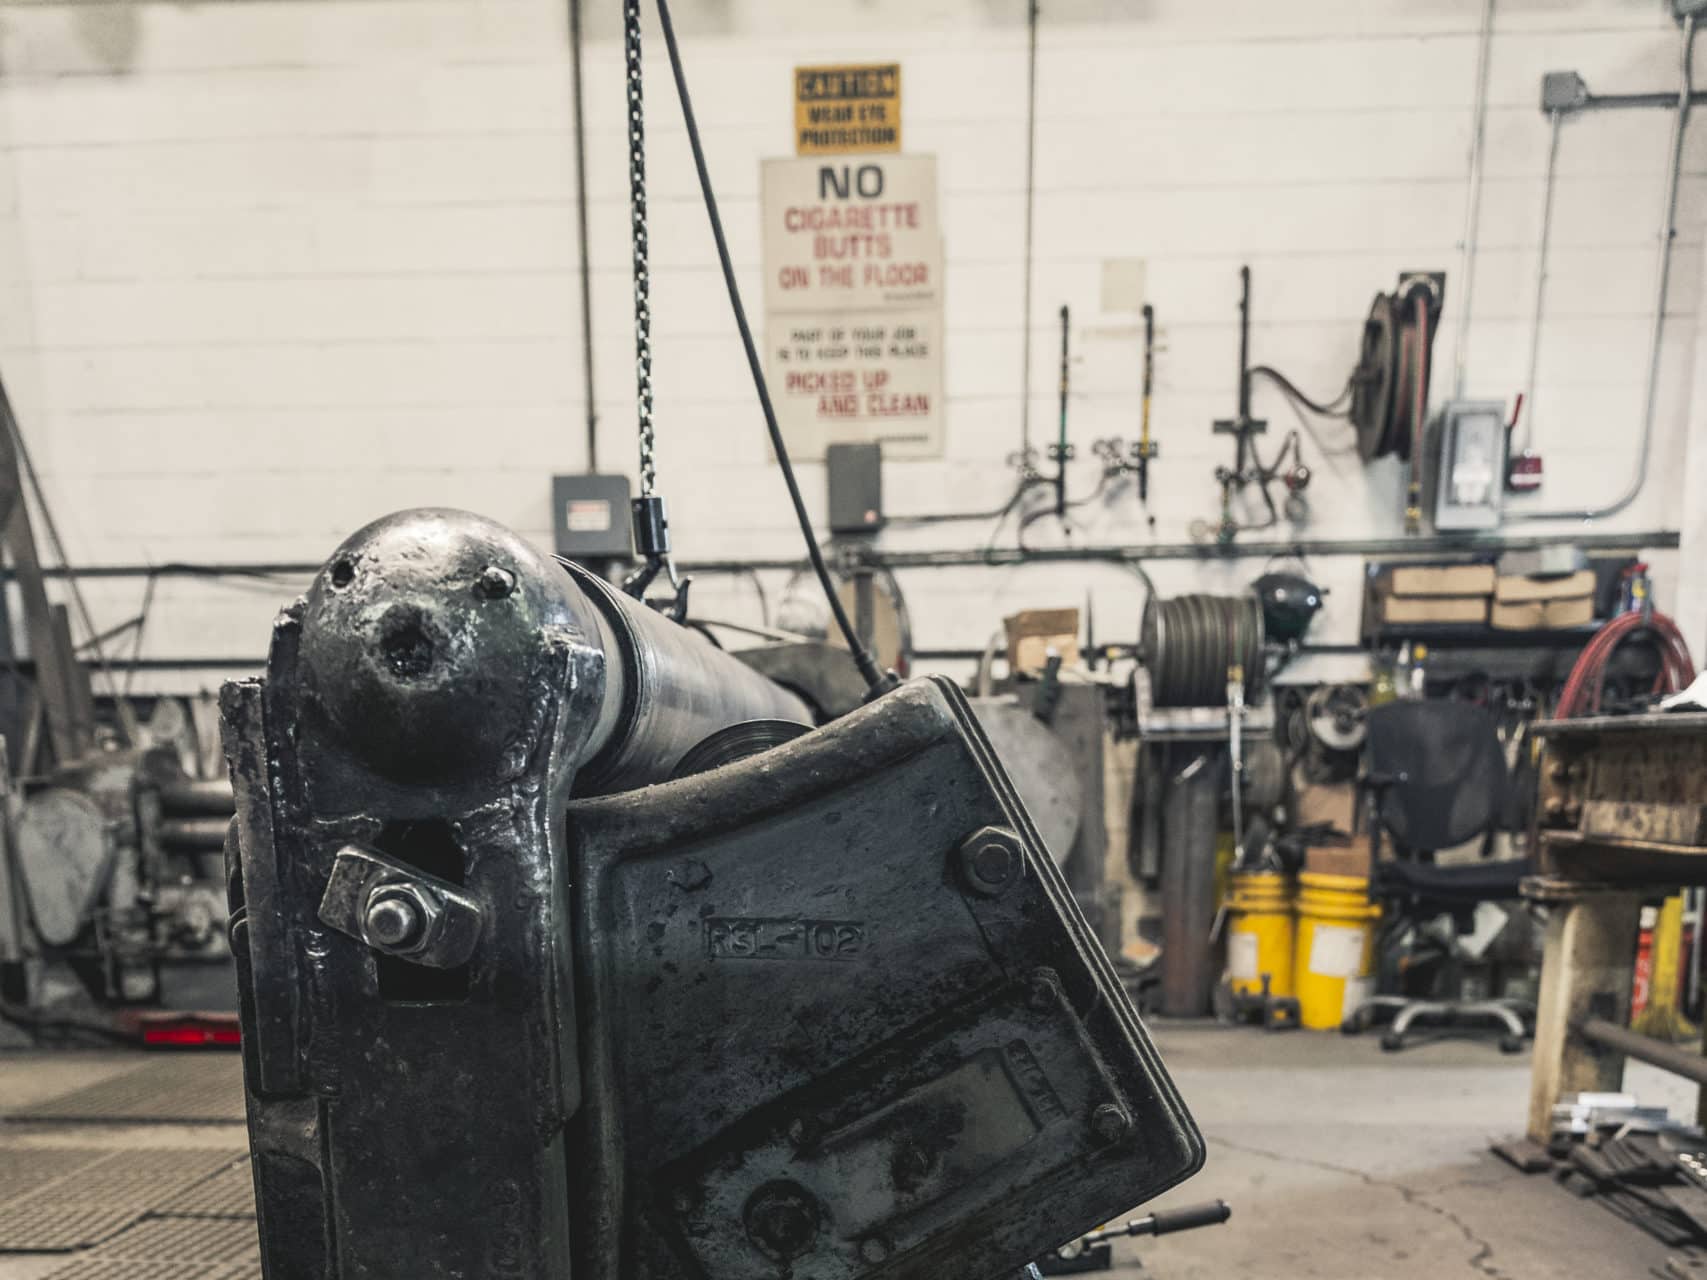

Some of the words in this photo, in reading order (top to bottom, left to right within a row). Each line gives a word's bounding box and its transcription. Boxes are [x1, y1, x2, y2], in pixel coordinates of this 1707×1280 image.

[800, 70, 895, 98] CAUTION
[801, 127, 896, 145] PROTECTION
[819, 164, 884, 199] NO
[784, 203, 919, 232] CIGARETTE
[813, 235, 892, 259] BUTTS
[778, 266, 808, 289] ON
[819, 265, 853, 287] THE
[863, 263, 928, 285] FLOOR
[786, 371, 856, 393] PICKED
[862, 370, 890, 389] UP
[817, 395, 858, 416] AND
[867, 393, 930, 416] CLEAN
